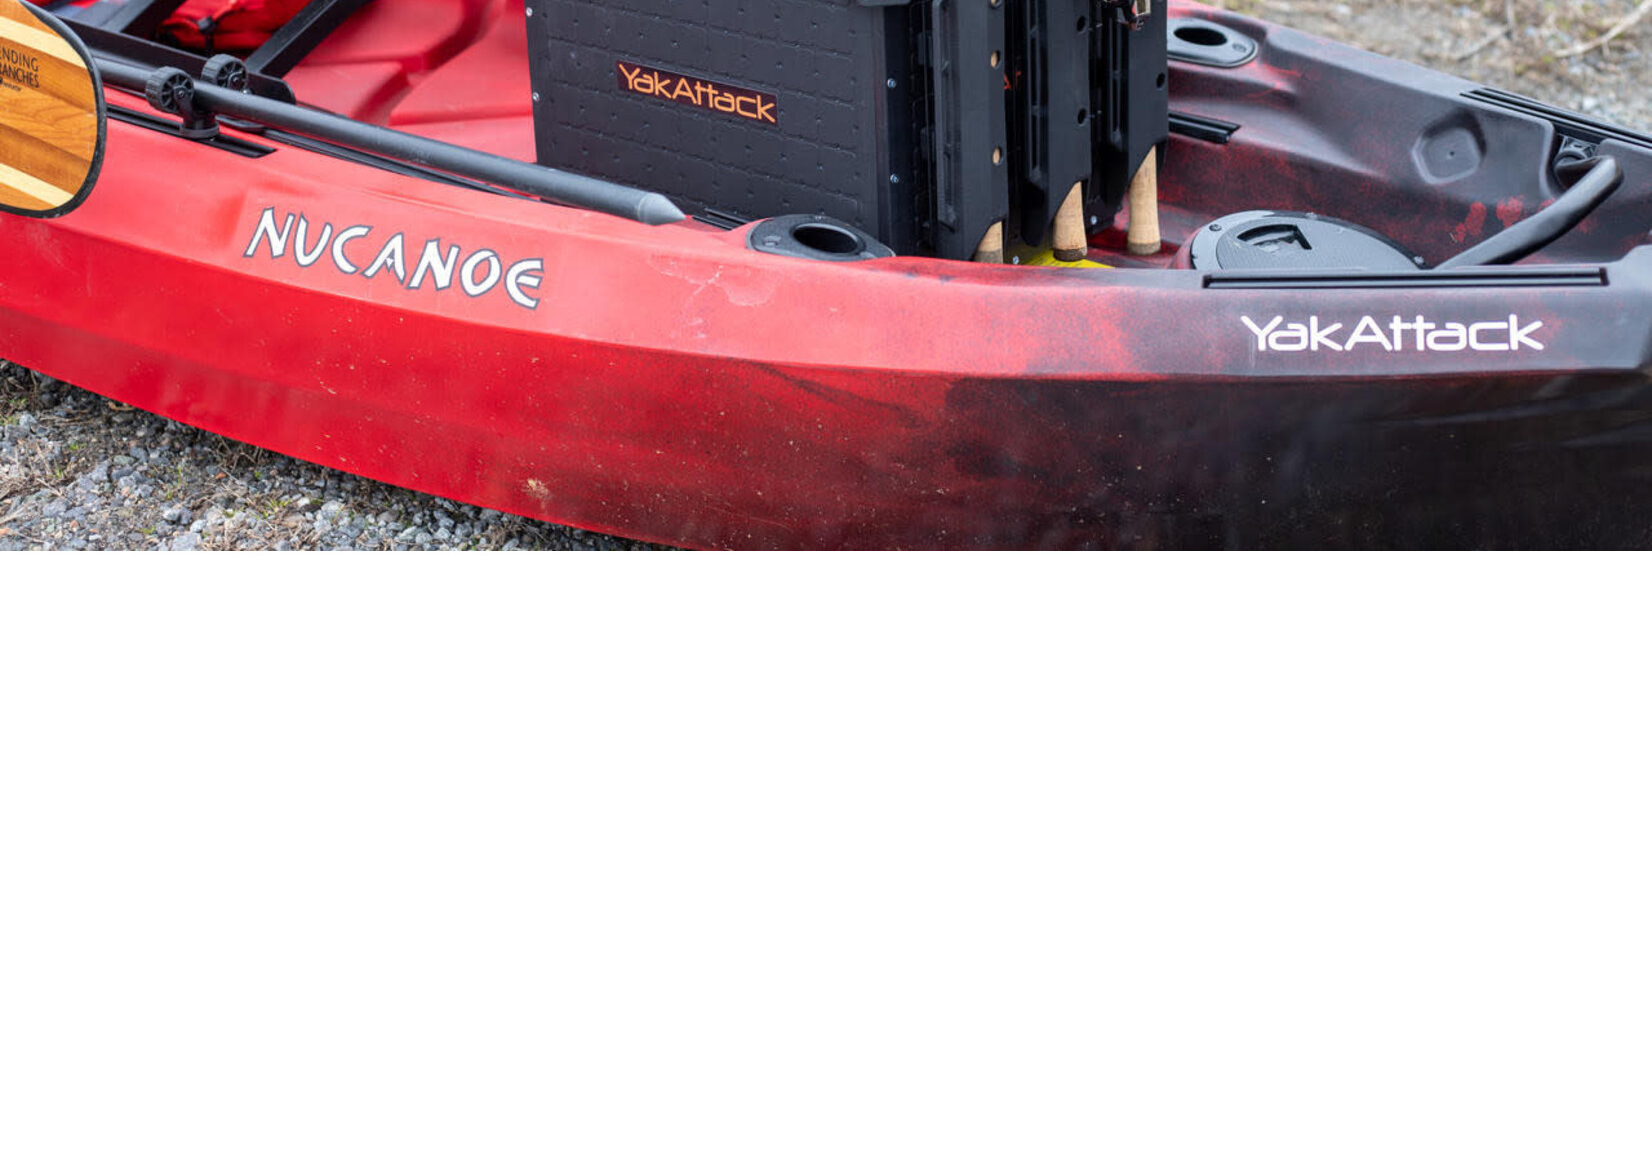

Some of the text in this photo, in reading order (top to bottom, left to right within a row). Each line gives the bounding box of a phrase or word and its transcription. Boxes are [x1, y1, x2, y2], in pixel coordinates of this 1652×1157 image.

[0, 46, 39, 72] NDING
[618, 63, 776, 123] YakAttack
[242, 206, 544, 310] NUCANOE
[1240, 313, 1545, 351] YakAttack
